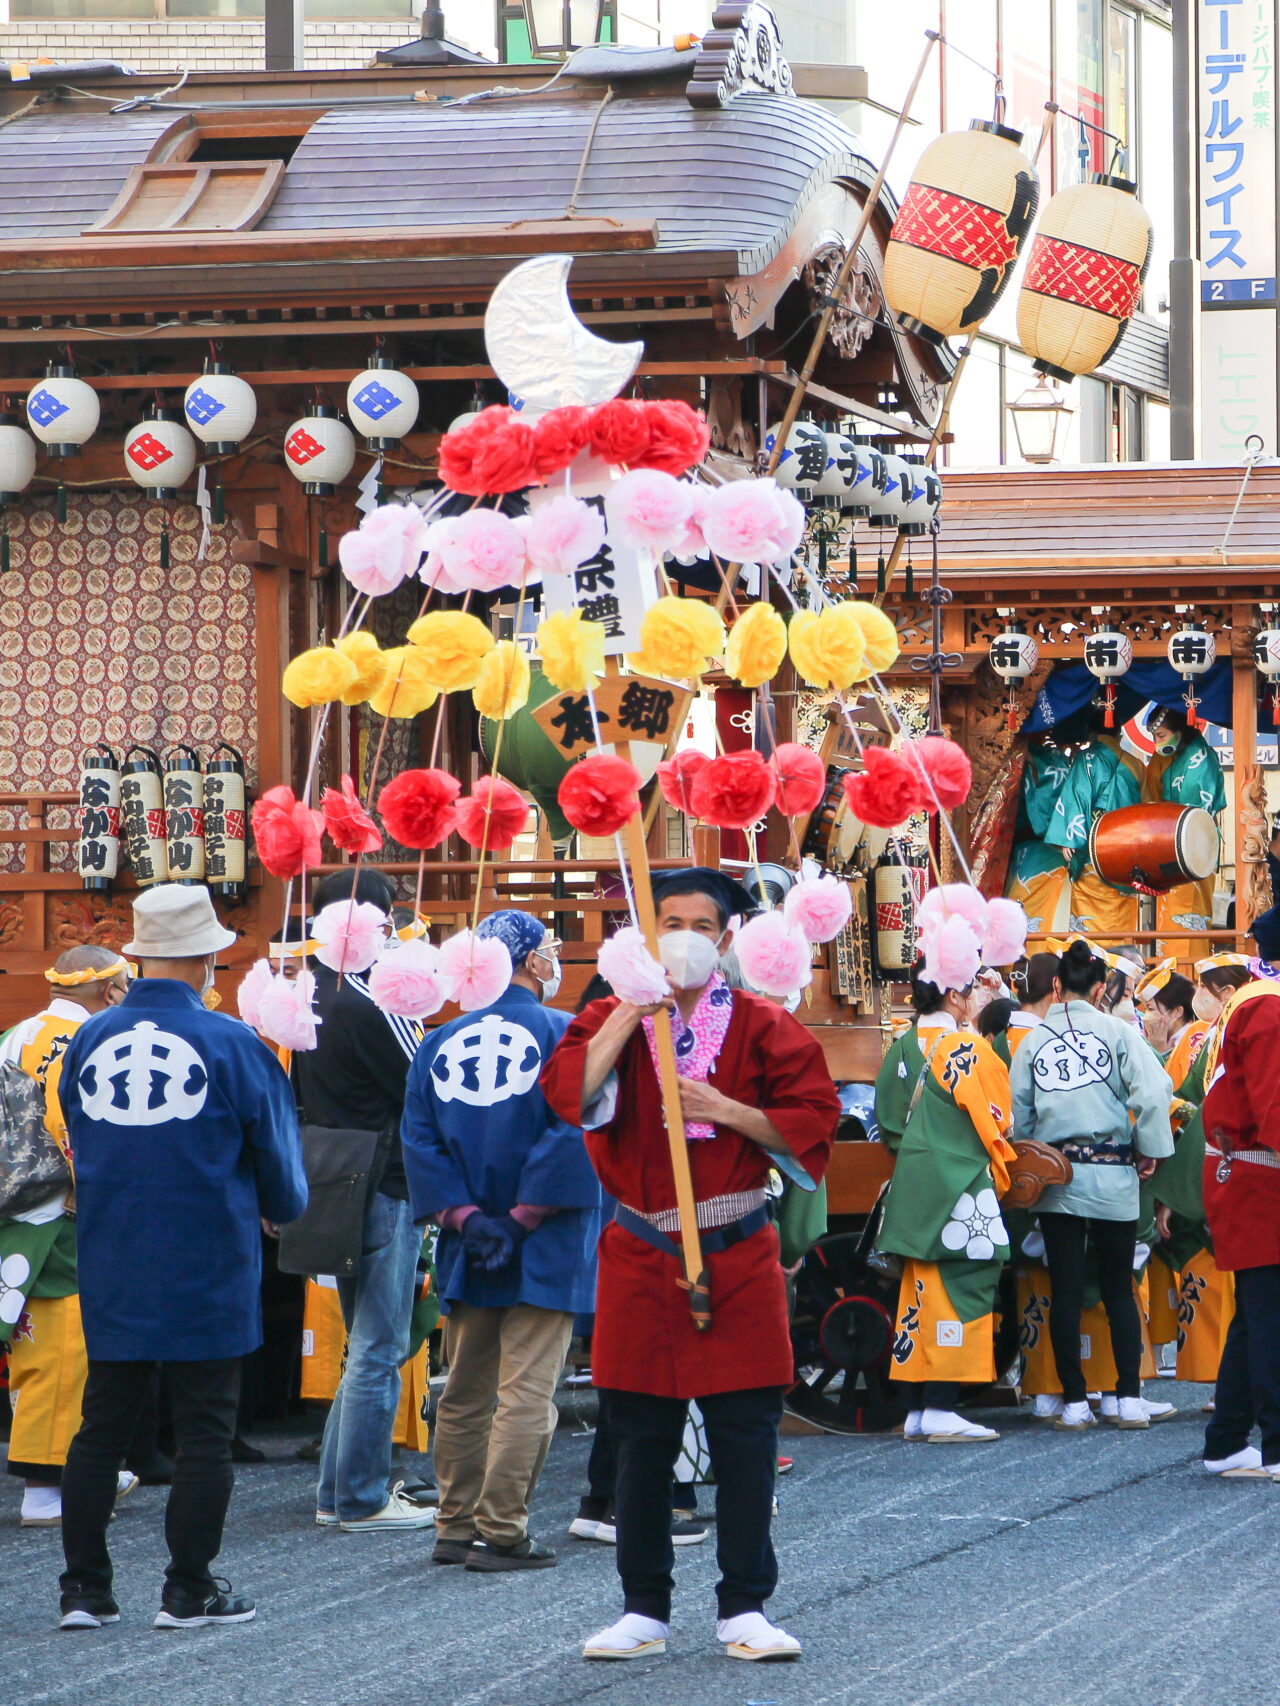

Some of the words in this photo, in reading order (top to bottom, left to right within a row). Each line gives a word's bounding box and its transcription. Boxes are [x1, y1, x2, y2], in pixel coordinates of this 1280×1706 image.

[1205, 0, 1247, 269] ーデルワイス
